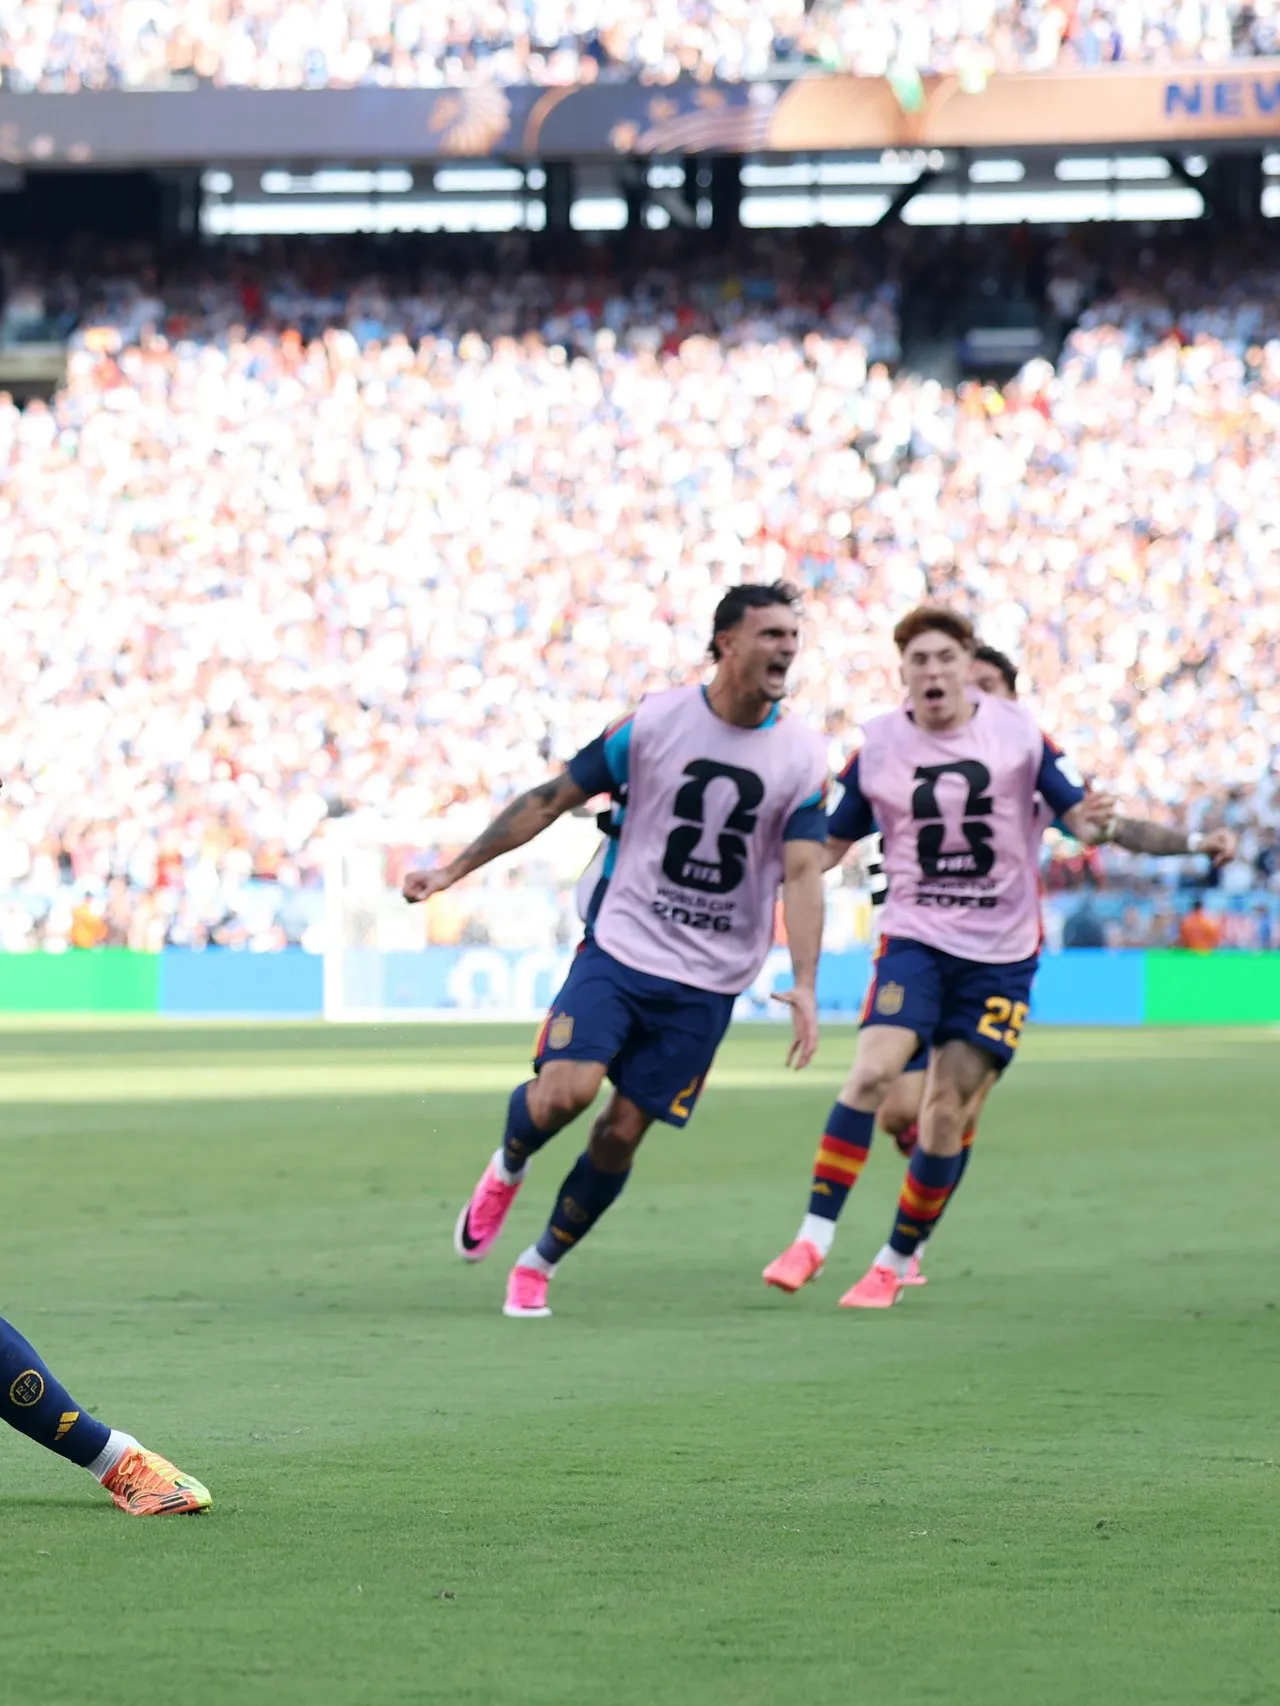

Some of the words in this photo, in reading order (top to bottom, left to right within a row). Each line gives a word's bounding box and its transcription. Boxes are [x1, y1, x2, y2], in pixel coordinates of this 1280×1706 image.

[681, 862, 723, 885] FIFA
[651, 901, 733, 934] 2026
[976, 996, 1029, 1049] 25
[671, 1076, 698, 1118] 2
